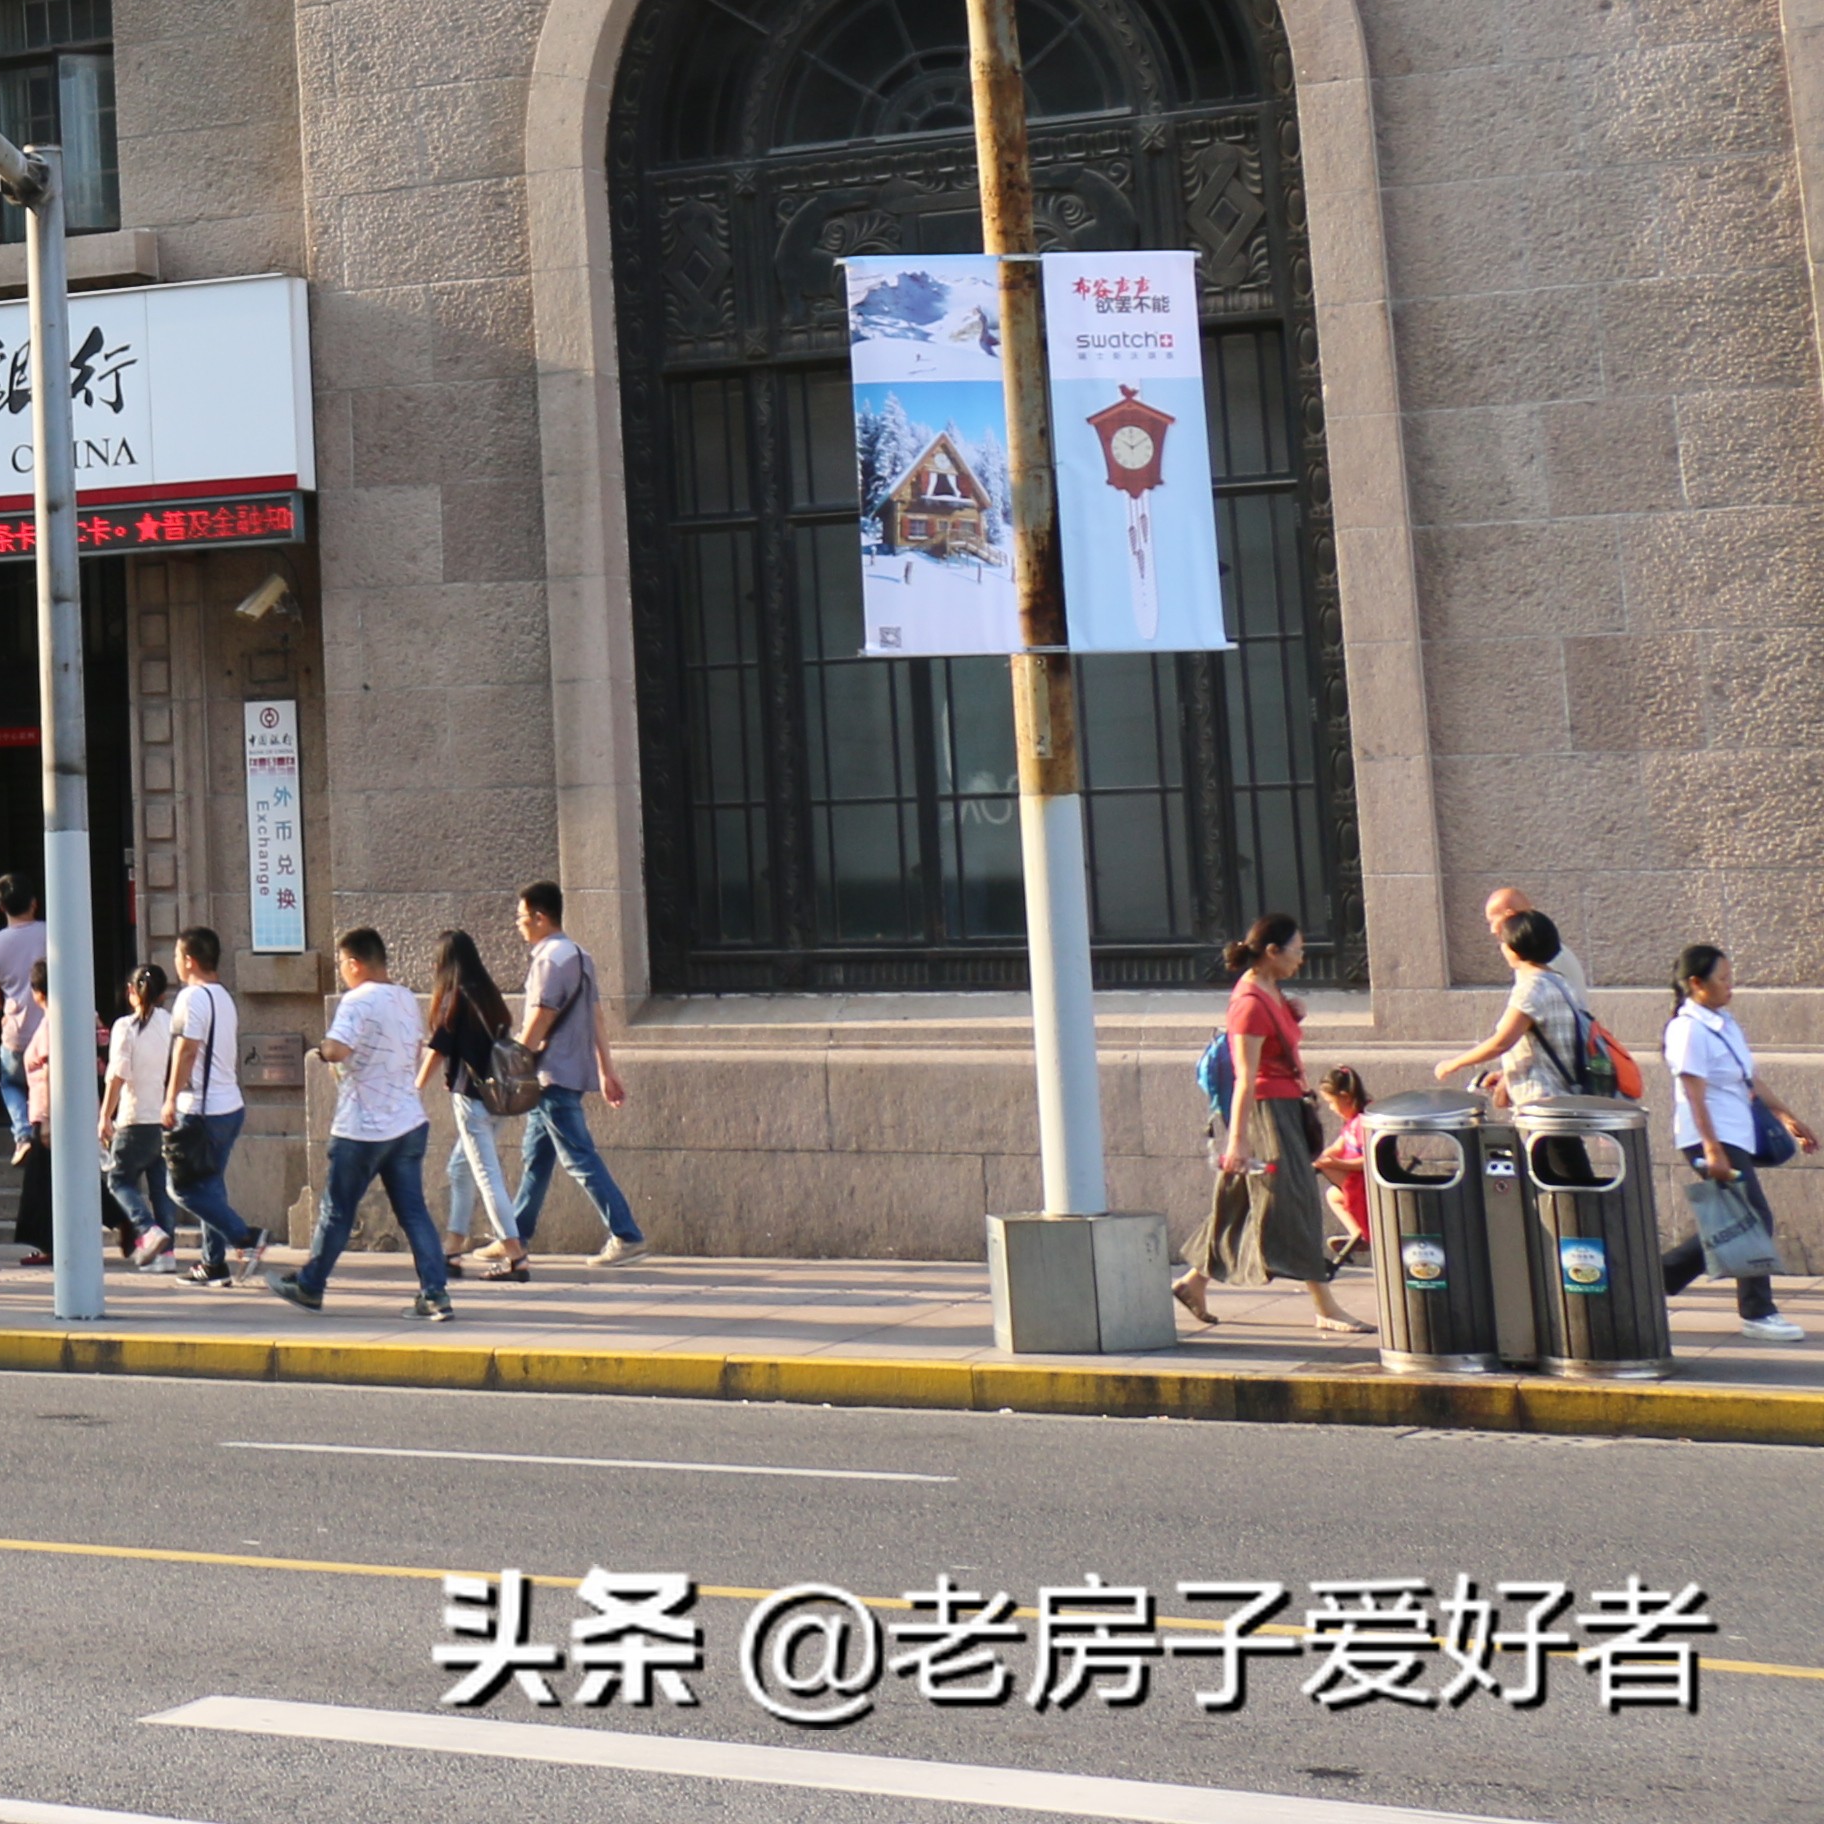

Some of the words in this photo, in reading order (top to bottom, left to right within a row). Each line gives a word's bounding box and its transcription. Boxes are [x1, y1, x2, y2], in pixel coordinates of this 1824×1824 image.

[1096, 295, 1170, 313] 欲罢不能
[1076, 331, 1158, 349] swatch
[11, 436, 138, 474] CINA
[256, 800, 270, 896] Exchange
[273, 785, 297, 910] 外币兑换
